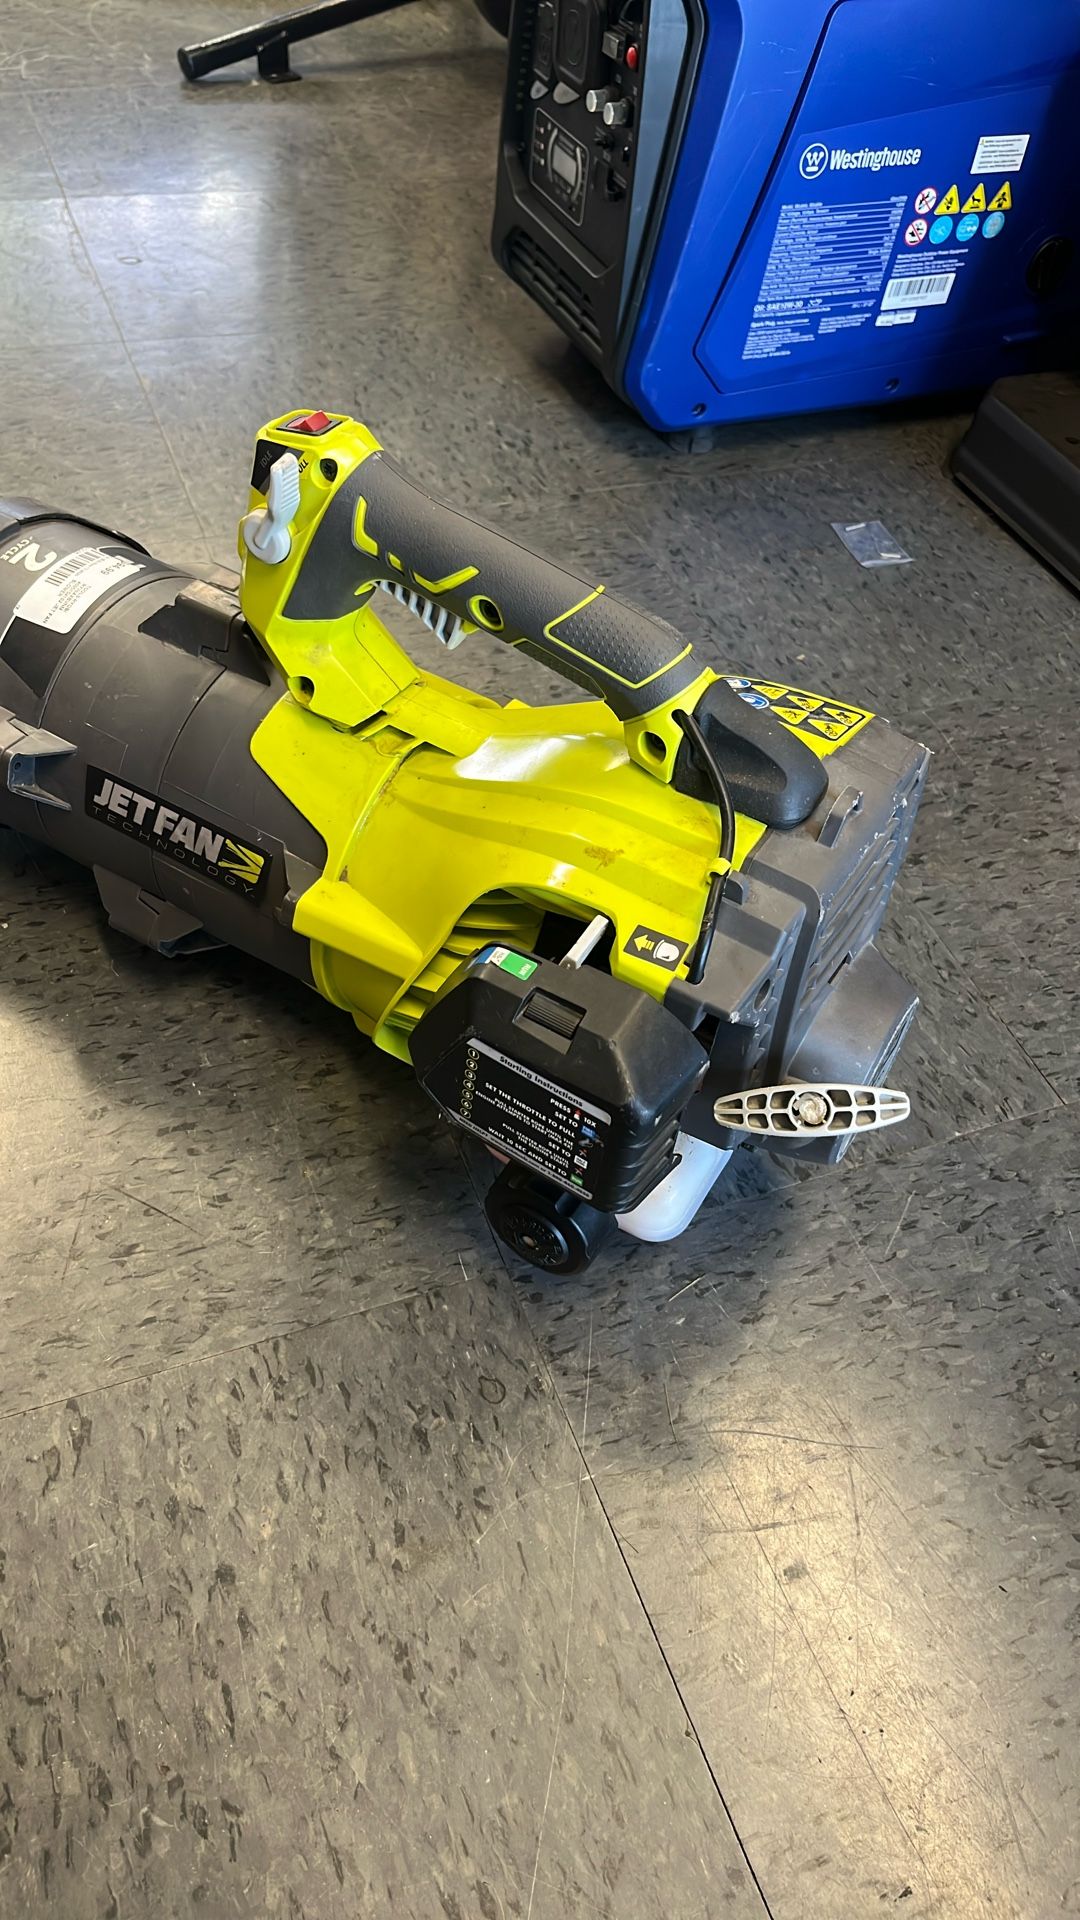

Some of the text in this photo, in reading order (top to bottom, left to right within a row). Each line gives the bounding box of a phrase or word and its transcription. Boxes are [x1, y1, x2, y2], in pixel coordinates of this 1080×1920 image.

[829, 147, 921, 171] Westinghouse
[298, 459, 309, 473] ULL
[9, 543, 58, 572] 2
[93, 778, 225, 864] JET FAN
[93, 806, 254, 893] TECHNOLOGY
[499, 1056, 583, 1107] Starting Instructions
[484, 1082, 497, 1092] SET
[497, 1089, 511, 1101] THE
[511, 1097, 546, 1121] THROTTLE
[547, 1118, 557, 1127] TO
[558, 1125, 575, 1138] FULL
[549, 1098, 596, 1128] PRESS 10X
[554, 1110, 578, 1128] SET TO
[487, 1126, 504, 1140] WAIT
[514, 1142, 527, 1153] SEC
[527, 1150, 543, 1162] AND
[544, 1160, 557, 1171] SET
[557, 1167, 567, 1177] TO
[547, 1141, 571, 1158] SET TO
